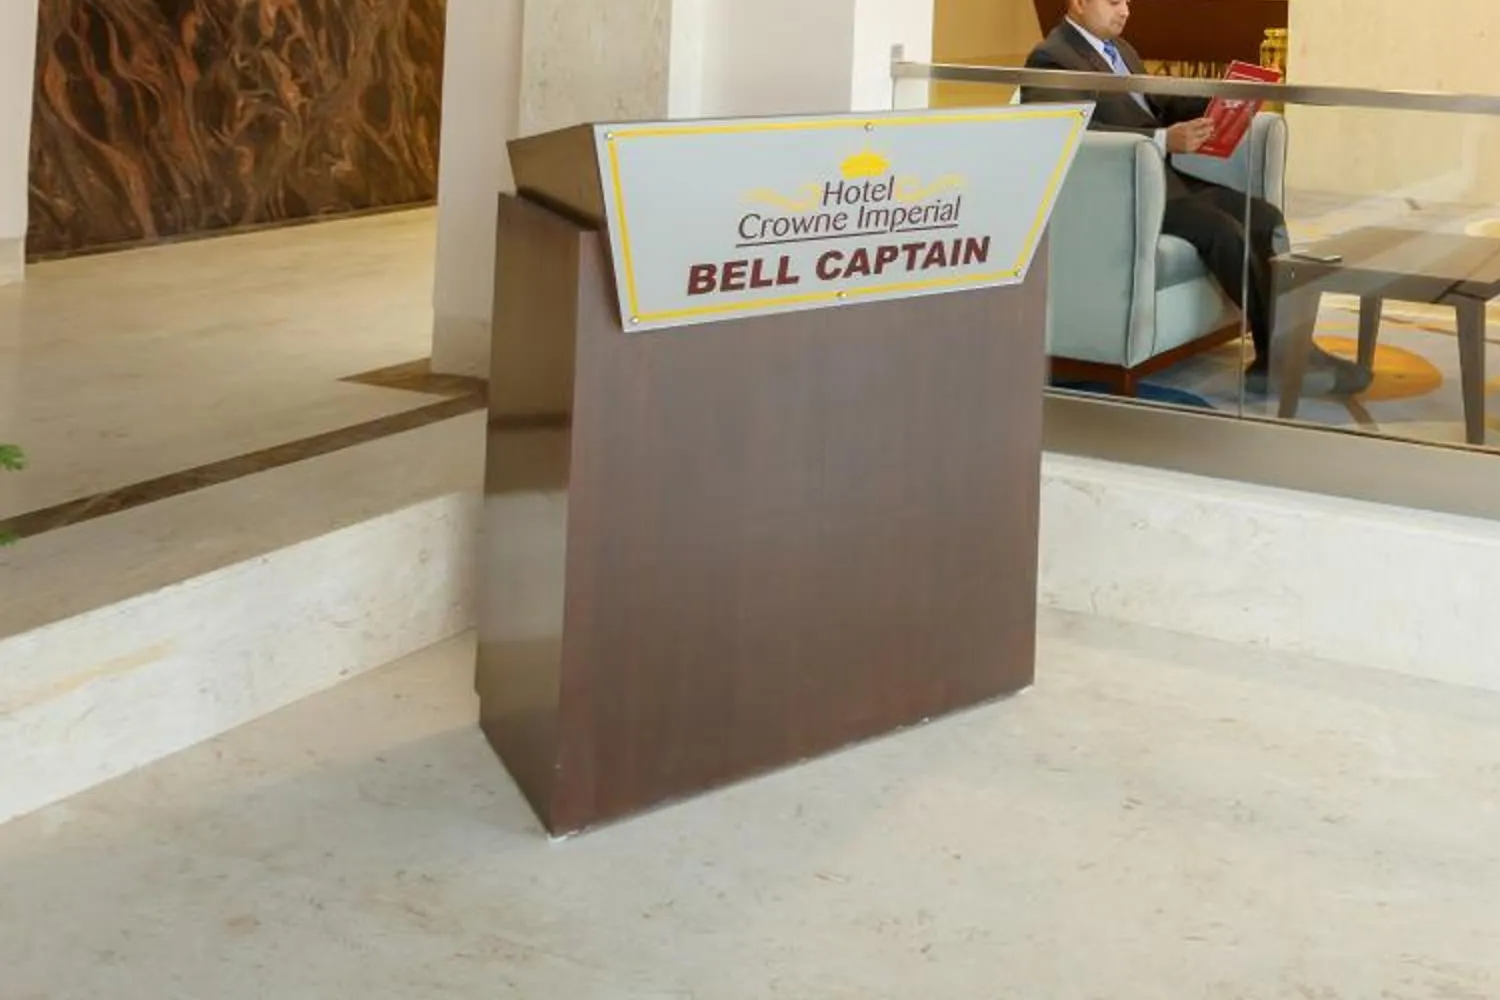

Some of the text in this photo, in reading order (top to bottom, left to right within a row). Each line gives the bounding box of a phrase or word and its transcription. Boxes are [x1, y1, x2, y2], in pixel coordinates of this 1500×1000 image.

[822, 175, 895, 206] Hotel
[737, 196, 961, 240] Crowne Imperial
[687, 235, 991, 296] BELL CAPTAIN
